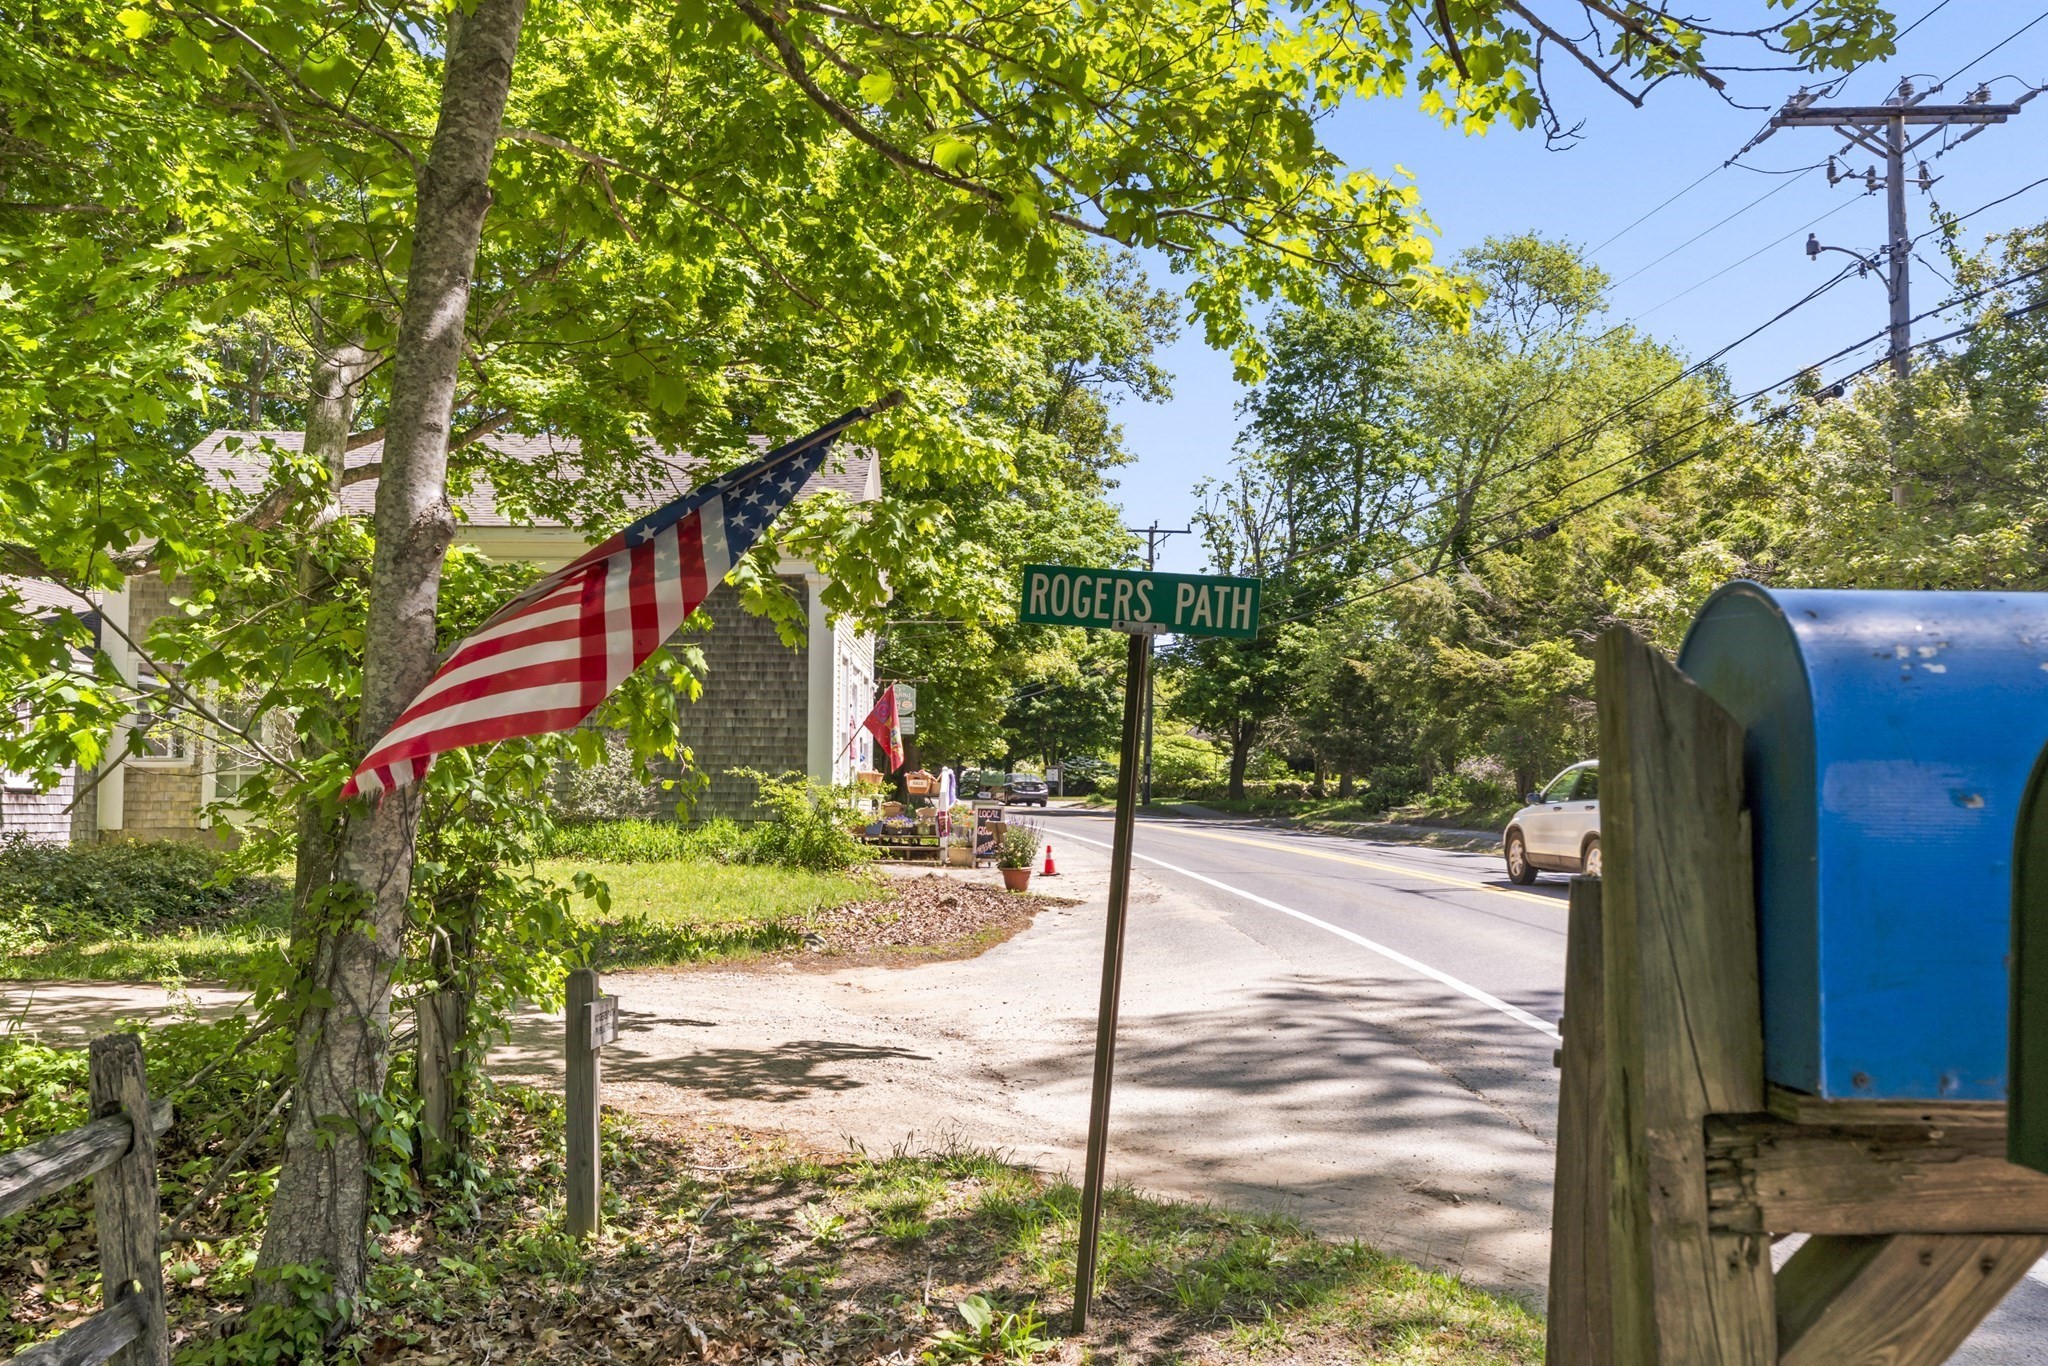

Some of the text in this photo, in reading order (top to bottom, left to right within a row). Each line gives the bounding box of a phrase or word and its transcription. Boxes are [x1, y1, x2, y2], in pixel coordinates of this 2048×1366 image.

[1029, 573, 1252, 630] ROGERS PATH
[979, 809, 1000, 819] LOCAL
